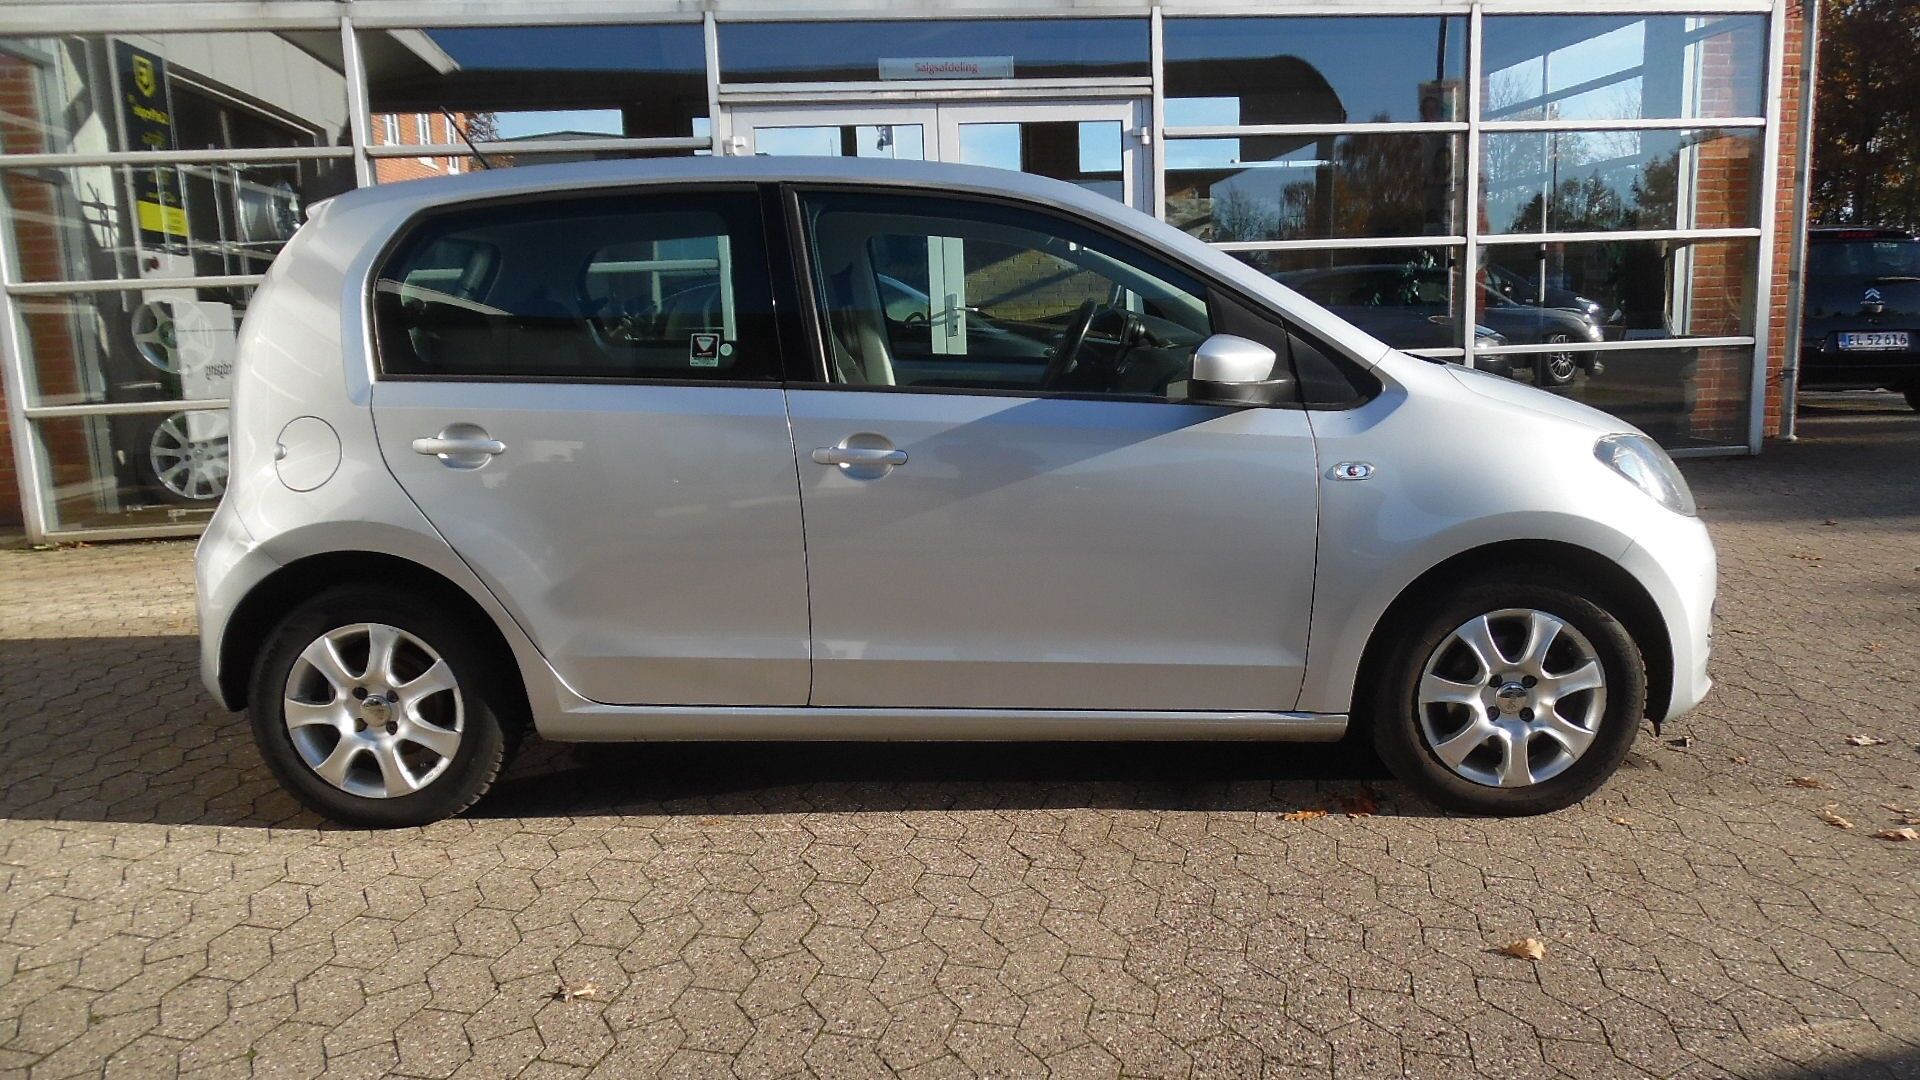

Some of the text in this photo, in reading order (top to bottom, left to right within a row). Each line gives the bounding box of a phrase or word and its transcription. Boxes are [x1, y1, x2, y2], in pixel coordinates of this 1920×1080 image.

[914, 61, 979, 75] Salgsafdeling
[1848, 333, 1908, 346] EL 52 616
